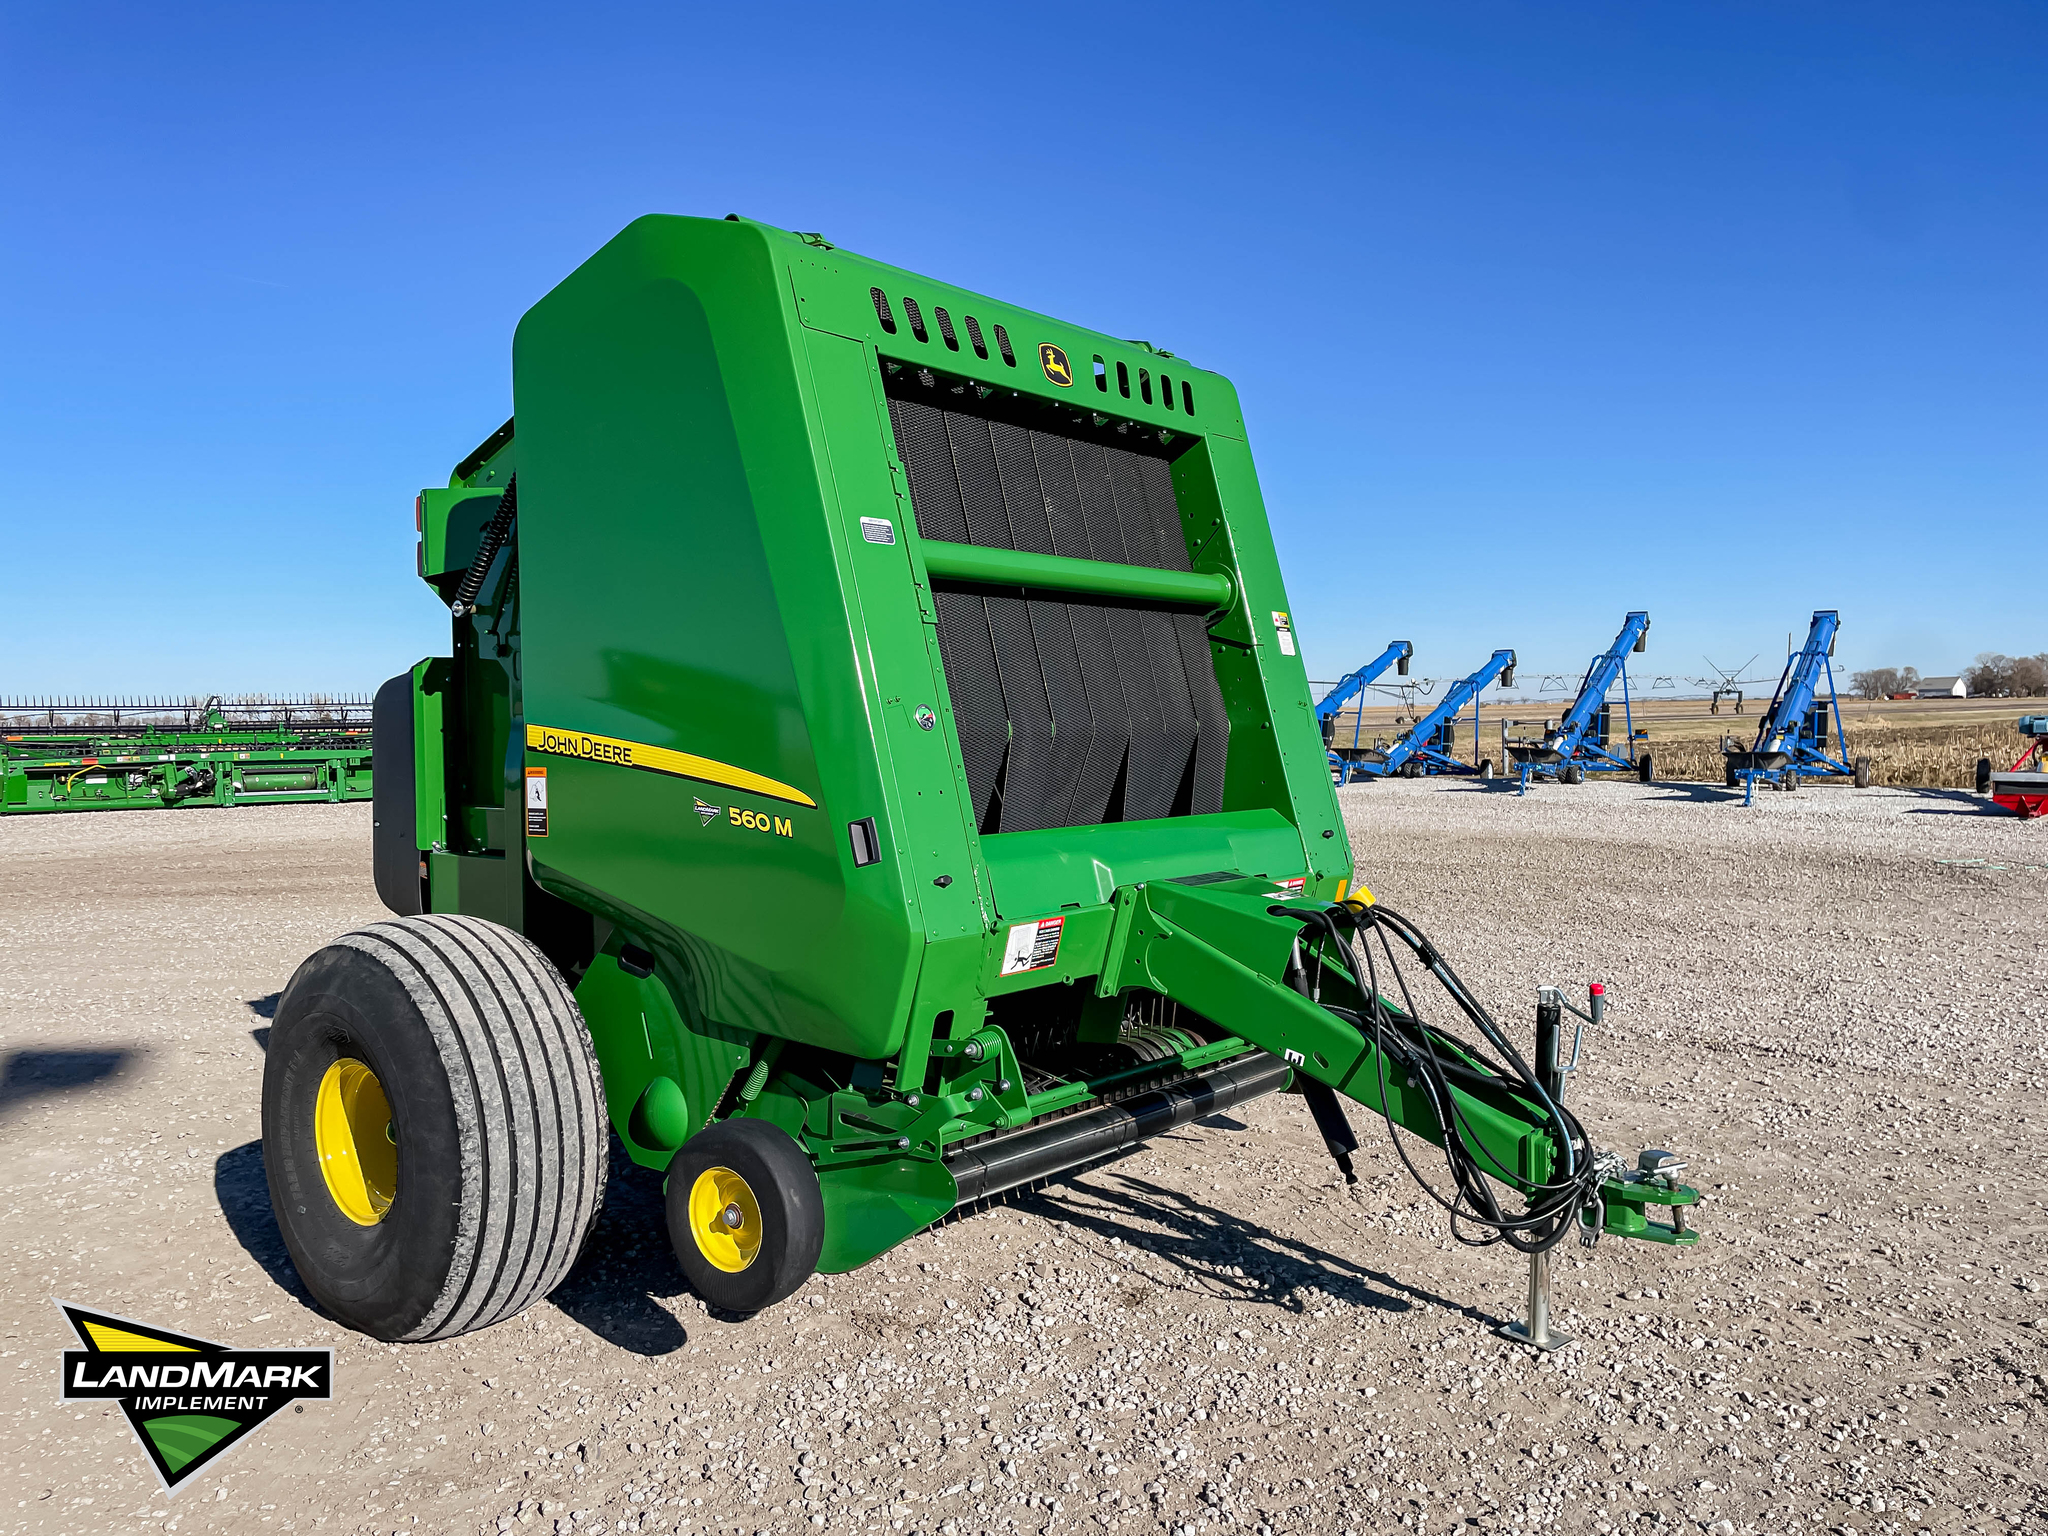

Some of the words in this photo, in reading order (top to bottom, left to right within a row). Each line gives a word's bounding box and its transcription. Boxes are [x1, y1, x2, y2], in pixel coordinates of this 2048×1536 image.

[538, 731, 578, 754] JOHN
[581, 737, 633, 763] DEERE
[728, 806, 771, 833] 560
[774, 815, 793, 838] M
